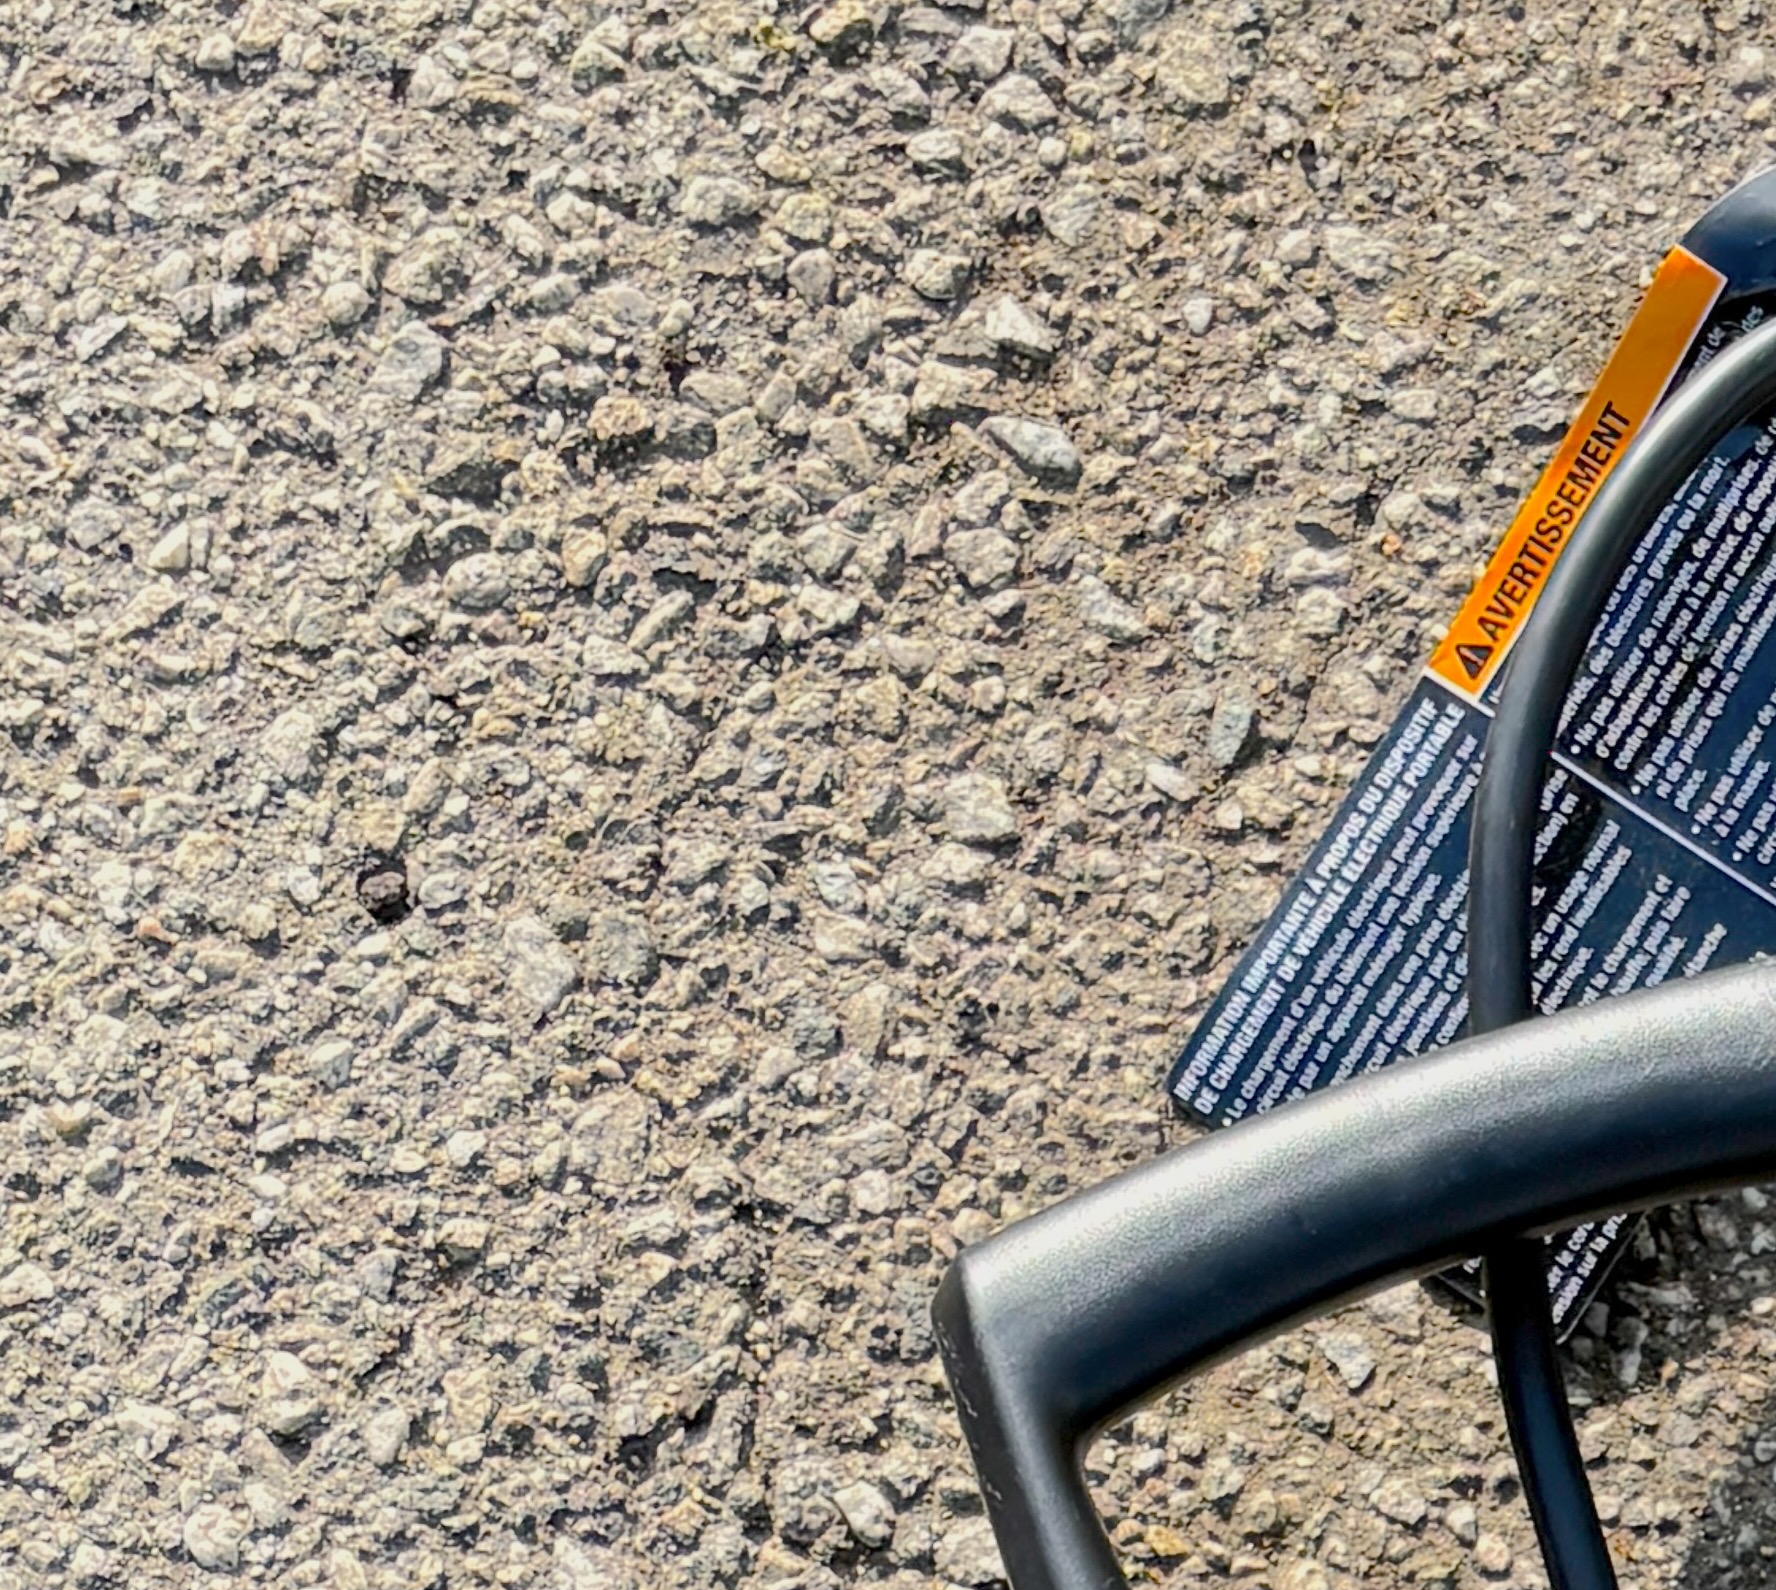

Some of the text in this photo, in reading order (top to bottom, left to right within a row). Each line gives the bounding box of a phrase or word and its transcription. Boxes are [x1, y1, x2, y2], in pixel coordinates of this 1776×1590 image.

[1477, 400, 1630, 642] AVERTISSEMENT
[1758, 704, 1776, 726] de
[1173, 990, 1251, 1101] INFORMATION
[1241, 891, 1317, 992] IMPORTANTE
[1306, 878, 1326, 894] À
[1316, 812, 1367, 879] PROPOS
[1374, 698, 1437, 788] DISPOSITIF
[1194, 703, 1465, 1114] DE CHARGEMENT DE VÉHICULE ÉLECTRIQUE PORTABLE
